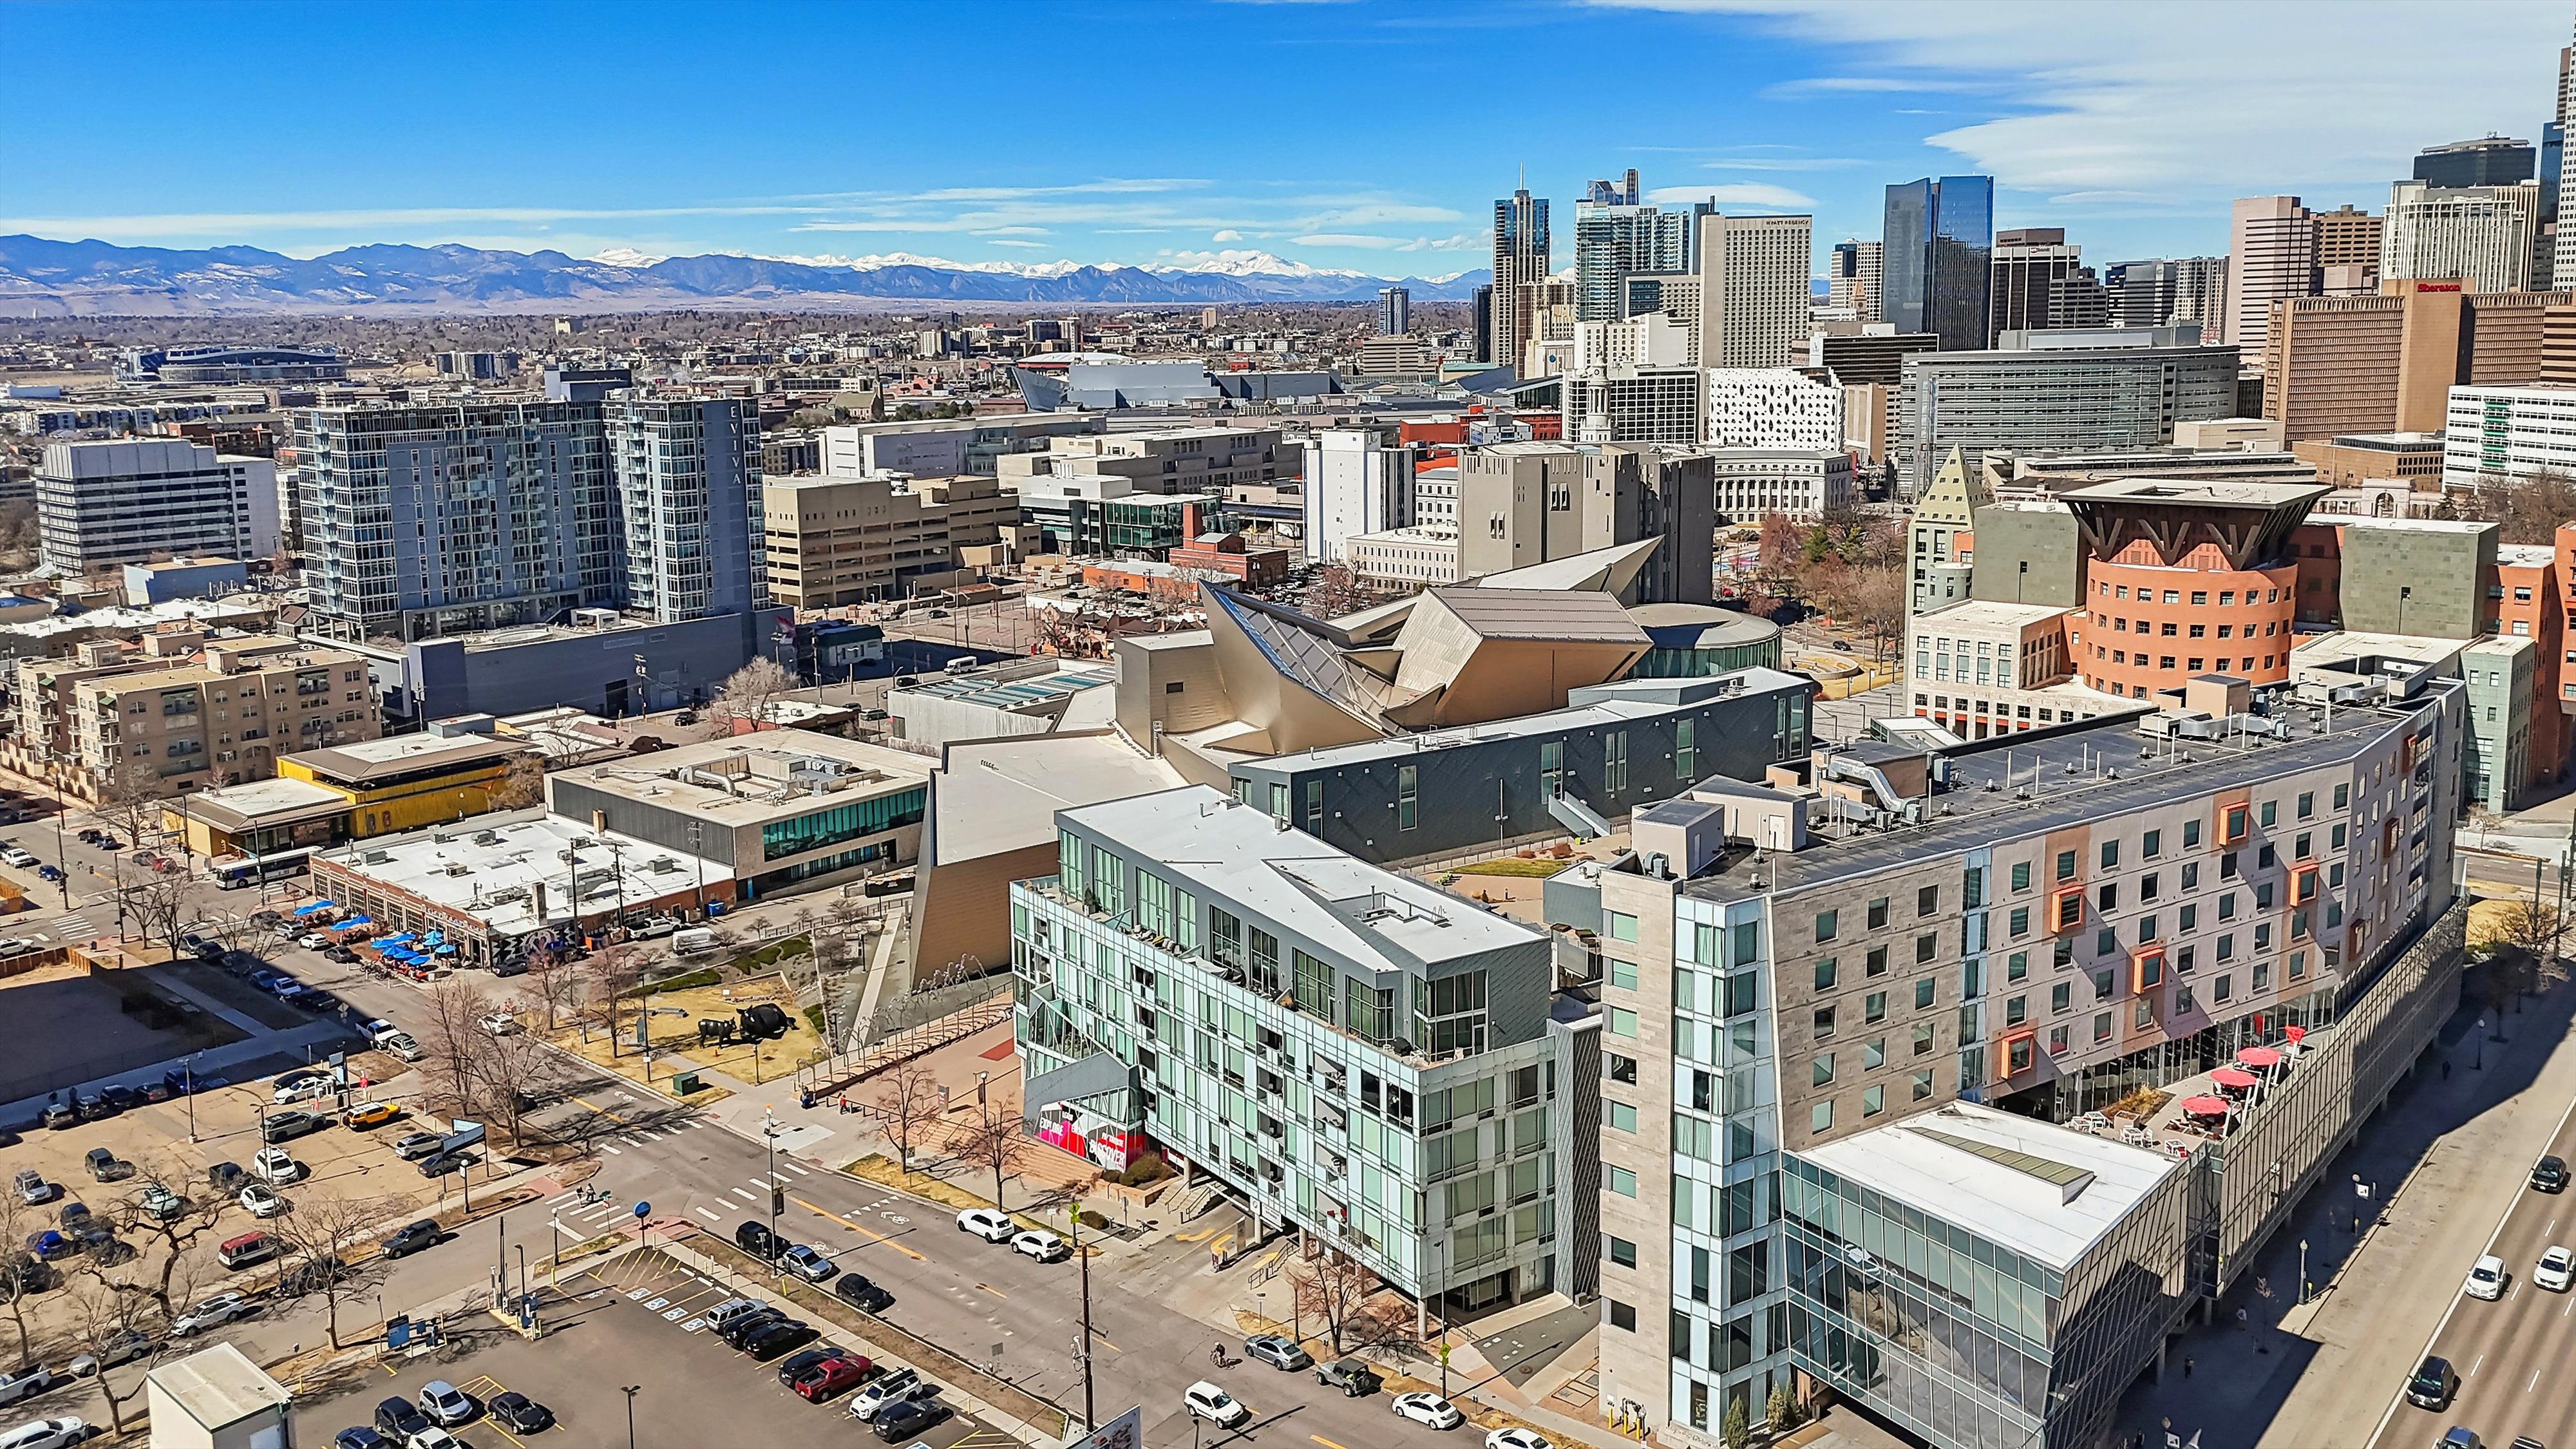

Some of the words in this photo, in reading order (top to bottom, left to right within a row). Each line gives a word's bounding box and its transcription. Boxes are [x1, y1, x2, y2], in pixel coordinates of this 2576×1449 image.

[2418, 283, 2461, 292] Sheraton
[730, 406, 741, 484] EVIVA
[1039, 1117, 1064, 1136] EXPLORE
